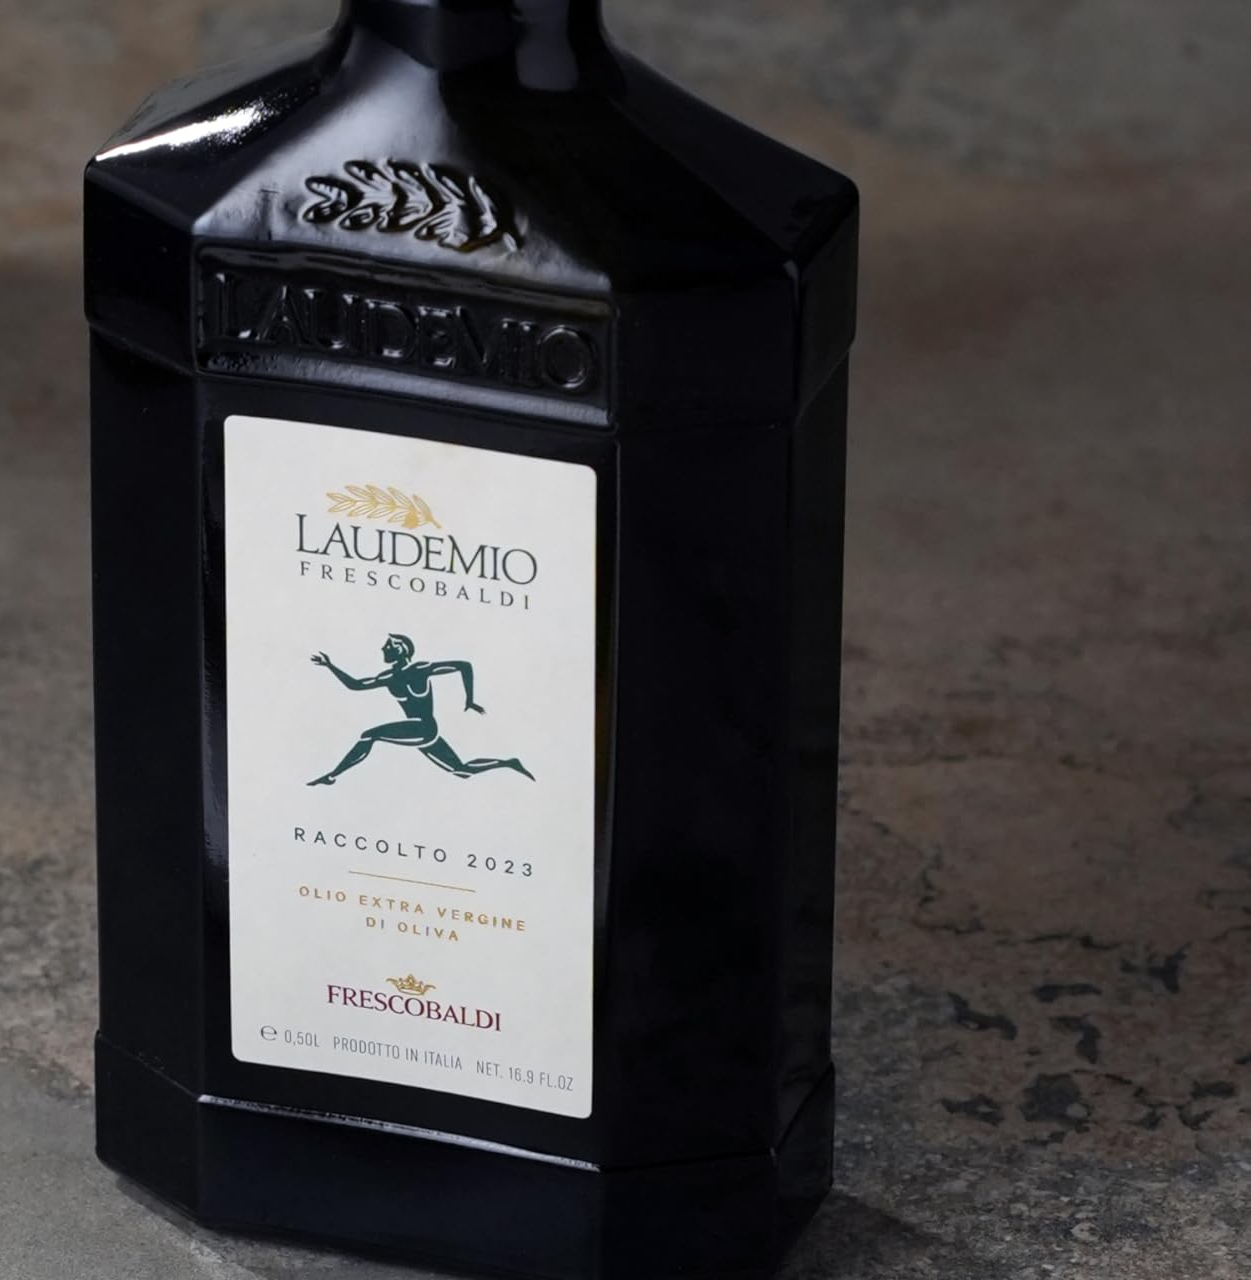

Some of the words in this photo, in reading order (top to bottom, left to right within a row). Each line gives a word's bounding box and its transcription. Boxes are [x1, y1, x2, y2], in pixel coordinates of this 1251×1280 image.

[295, 512, 539, 586] LAUDEMIO
[300, 560, 530, 611] FRESCOBALDI
[294, 826, 447, 863] RACCOLTO
[466, 853, 533, 878] 2023
[298, 885, 347, 903] OLIO
[358, 894, 425, 915] EXTRA
[436, 906, 526, 932] VERGINE
[365, 916, 386, 930] DI
[397, 921, 459, 942] OLIVA
[326, 983, 502, 1033] FRESCOBALDI
[284, 1029, 320, 1048] 0,50L
[333, 1036, 400, 1060] PRODOTTO
[405, 1047, 419, 1063] IN
[424, 1050, 463, 1070] ITALIA
[476, 1060, 503, 1079] NET.
[508, 1066, 534, 1085] 16.9
[539, 1071, 574, 1092] FL.OZ
